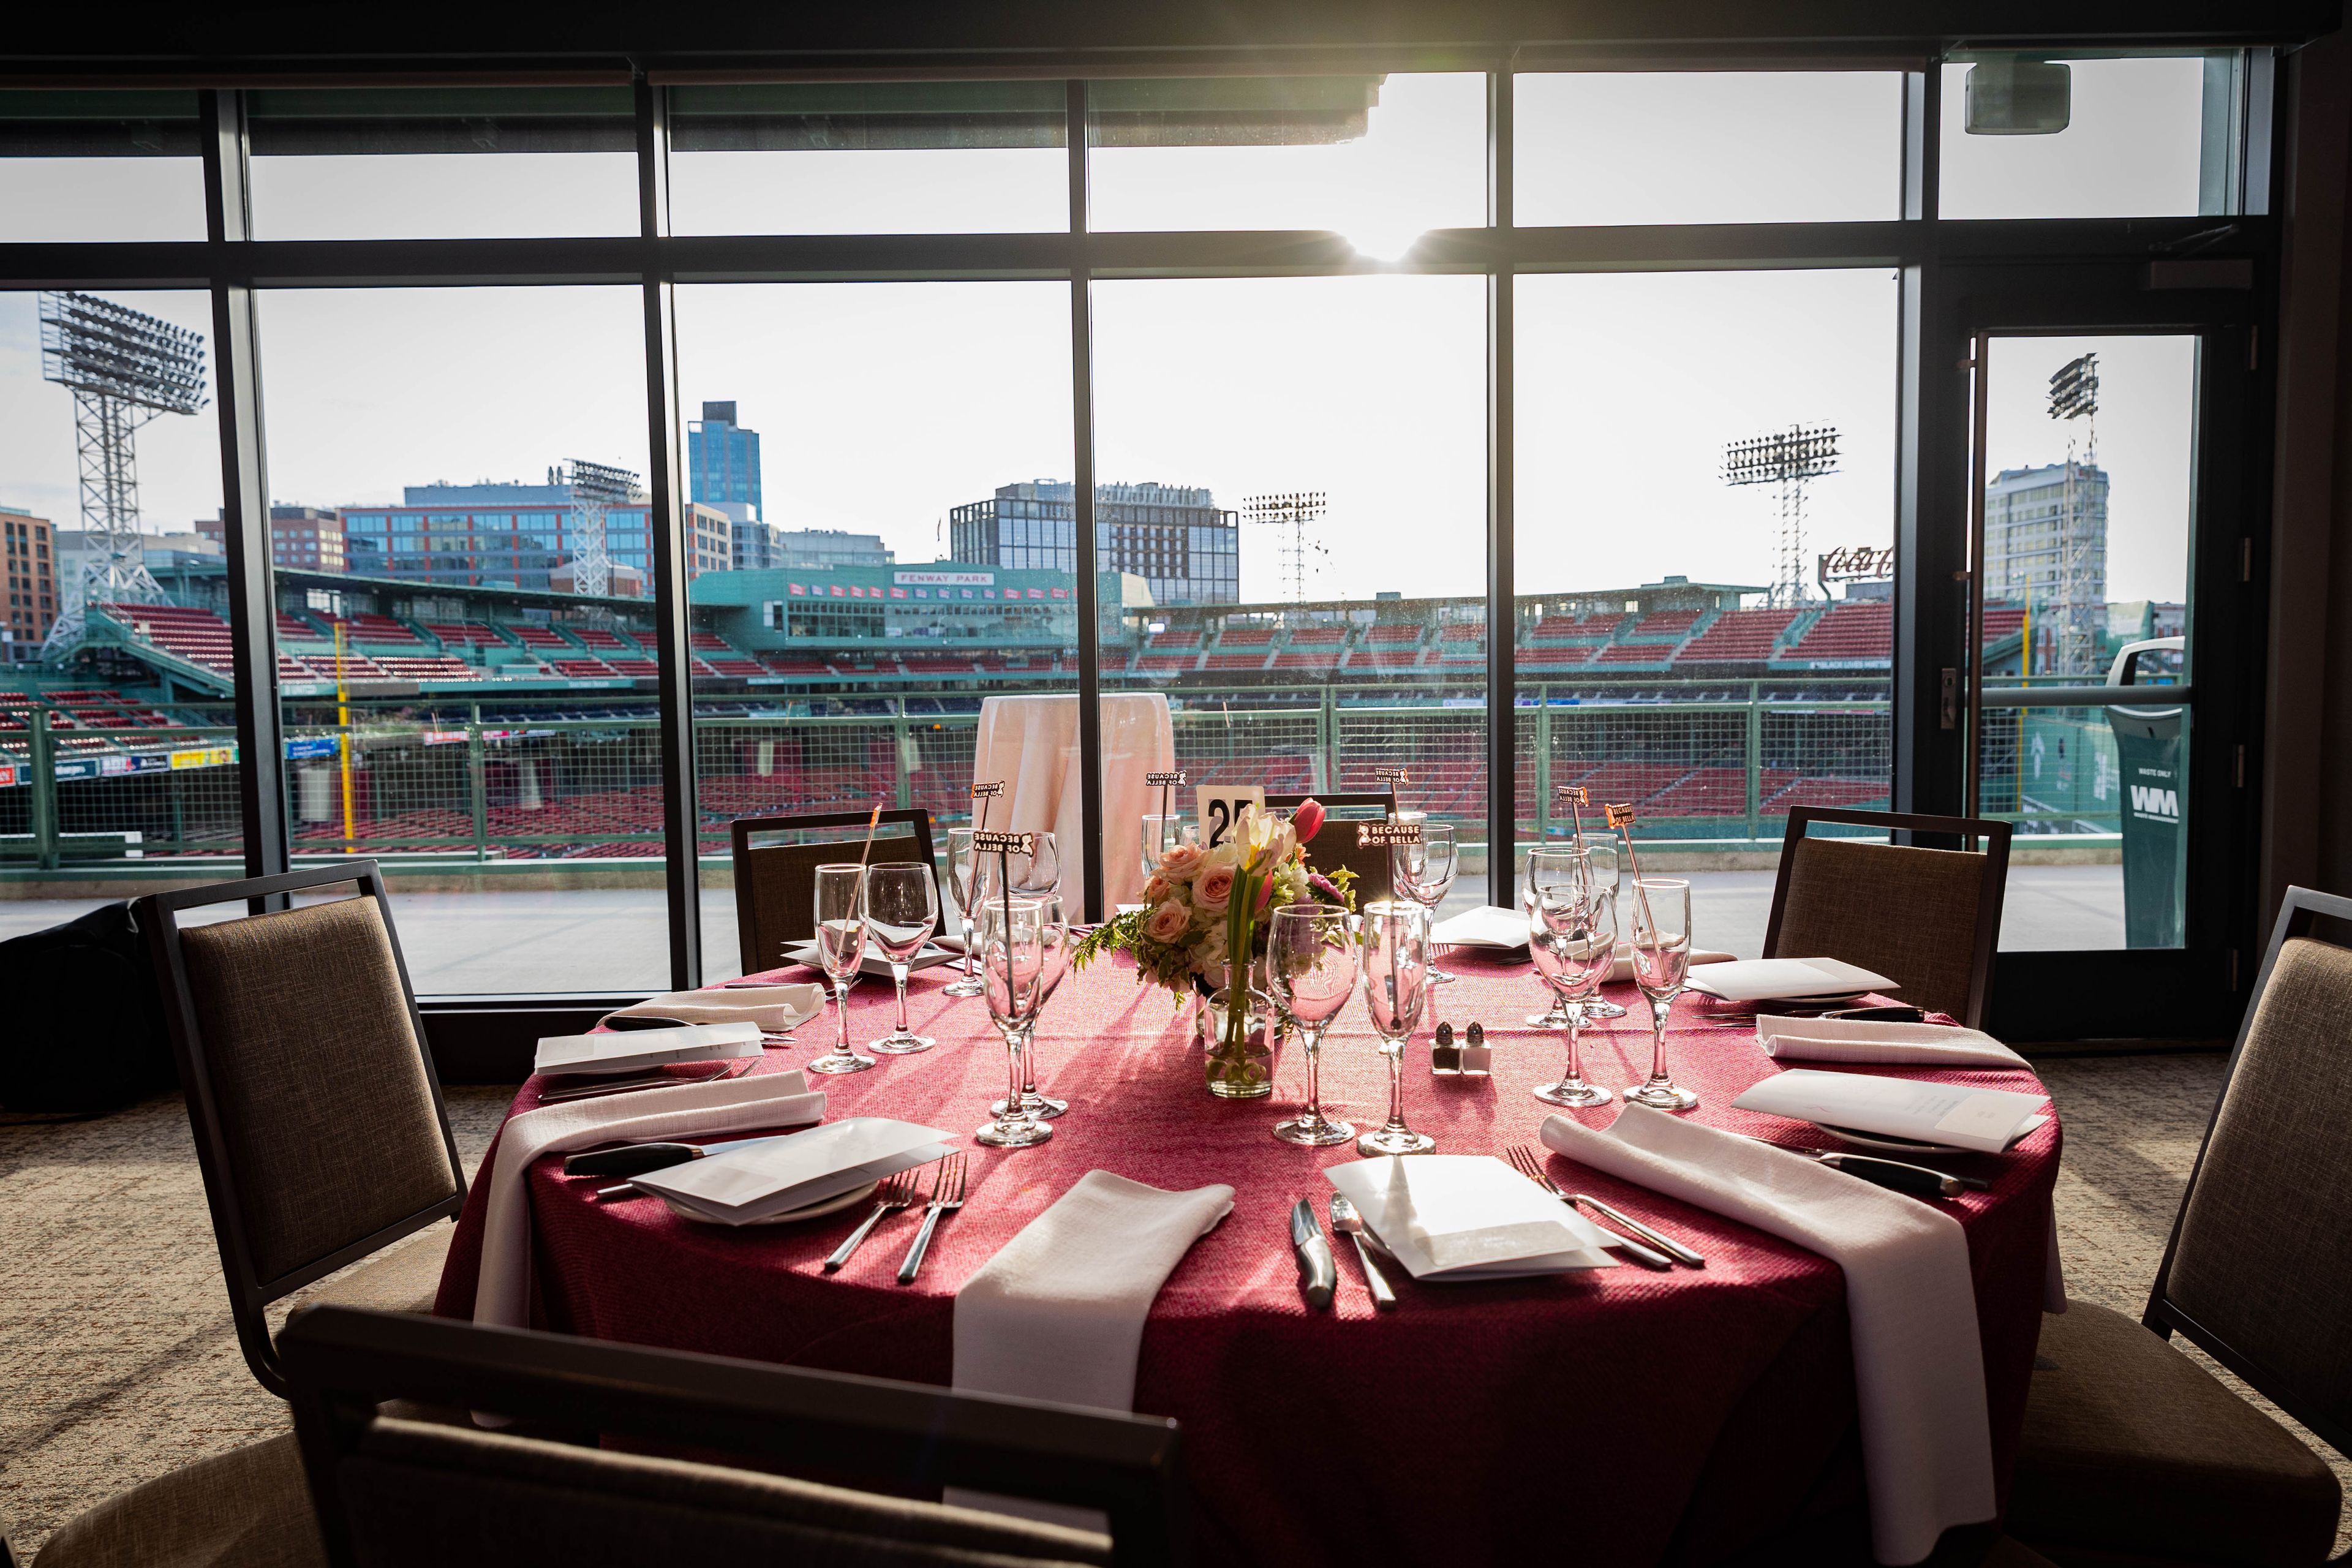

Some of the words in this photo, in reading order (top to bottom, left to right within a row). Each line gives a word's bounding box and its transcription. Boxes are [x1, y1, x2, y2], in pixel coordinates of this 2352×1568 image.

[2138, 767, 2156, 777] WASTE
[2157, 769, 2171, 778] ONLY
[2130, 785, 2179, 816] WM
[1613, 806, 1632, 815] BECAUSE
[1372, 826, 1420, 834] BECAUSE
[1390, 835, 1420, 844] BELLA
